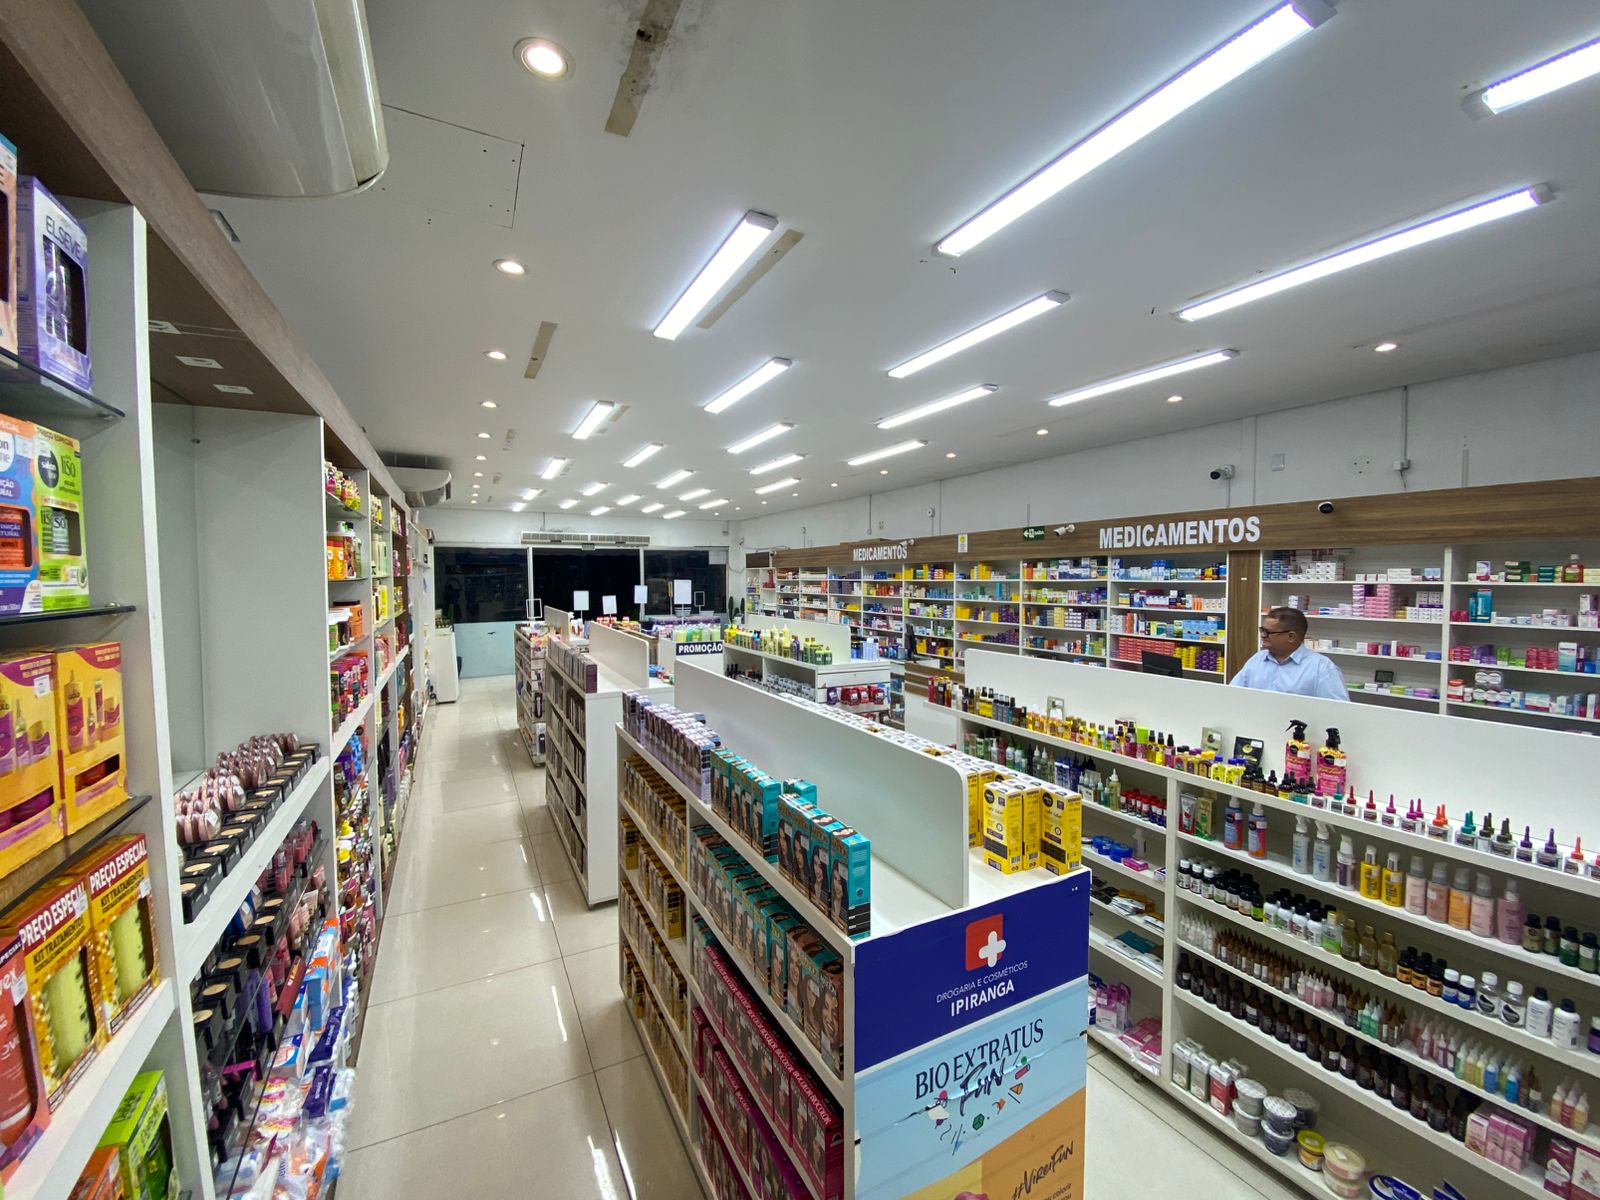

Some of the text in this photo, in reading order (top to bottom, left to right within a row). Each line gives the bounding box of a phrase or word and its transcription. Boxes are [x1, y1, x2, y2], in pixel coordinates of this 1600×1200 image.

[45, 215, 81, 260] ELSEVE
[1099, 516, 1261, 549] MEDICAMENTOS
[853, 544, 907, 561] MEDICAMENTOS
[678, 642, 723, 654] PROMOÇÃO
[89, 839, 147, 894] PREÇO ESPECIAL
[19, 910, 53, 951] PREÇO
[936, 960, 1028, 1003] DROGARIA E COSMÉTICOS
[951, 979, 1015, 1017] IPIRANGA
[915, 1018, 1044, 1100] BIO EXTRATUS
[809, 1093, 832, 1125] BIOCOLOR
